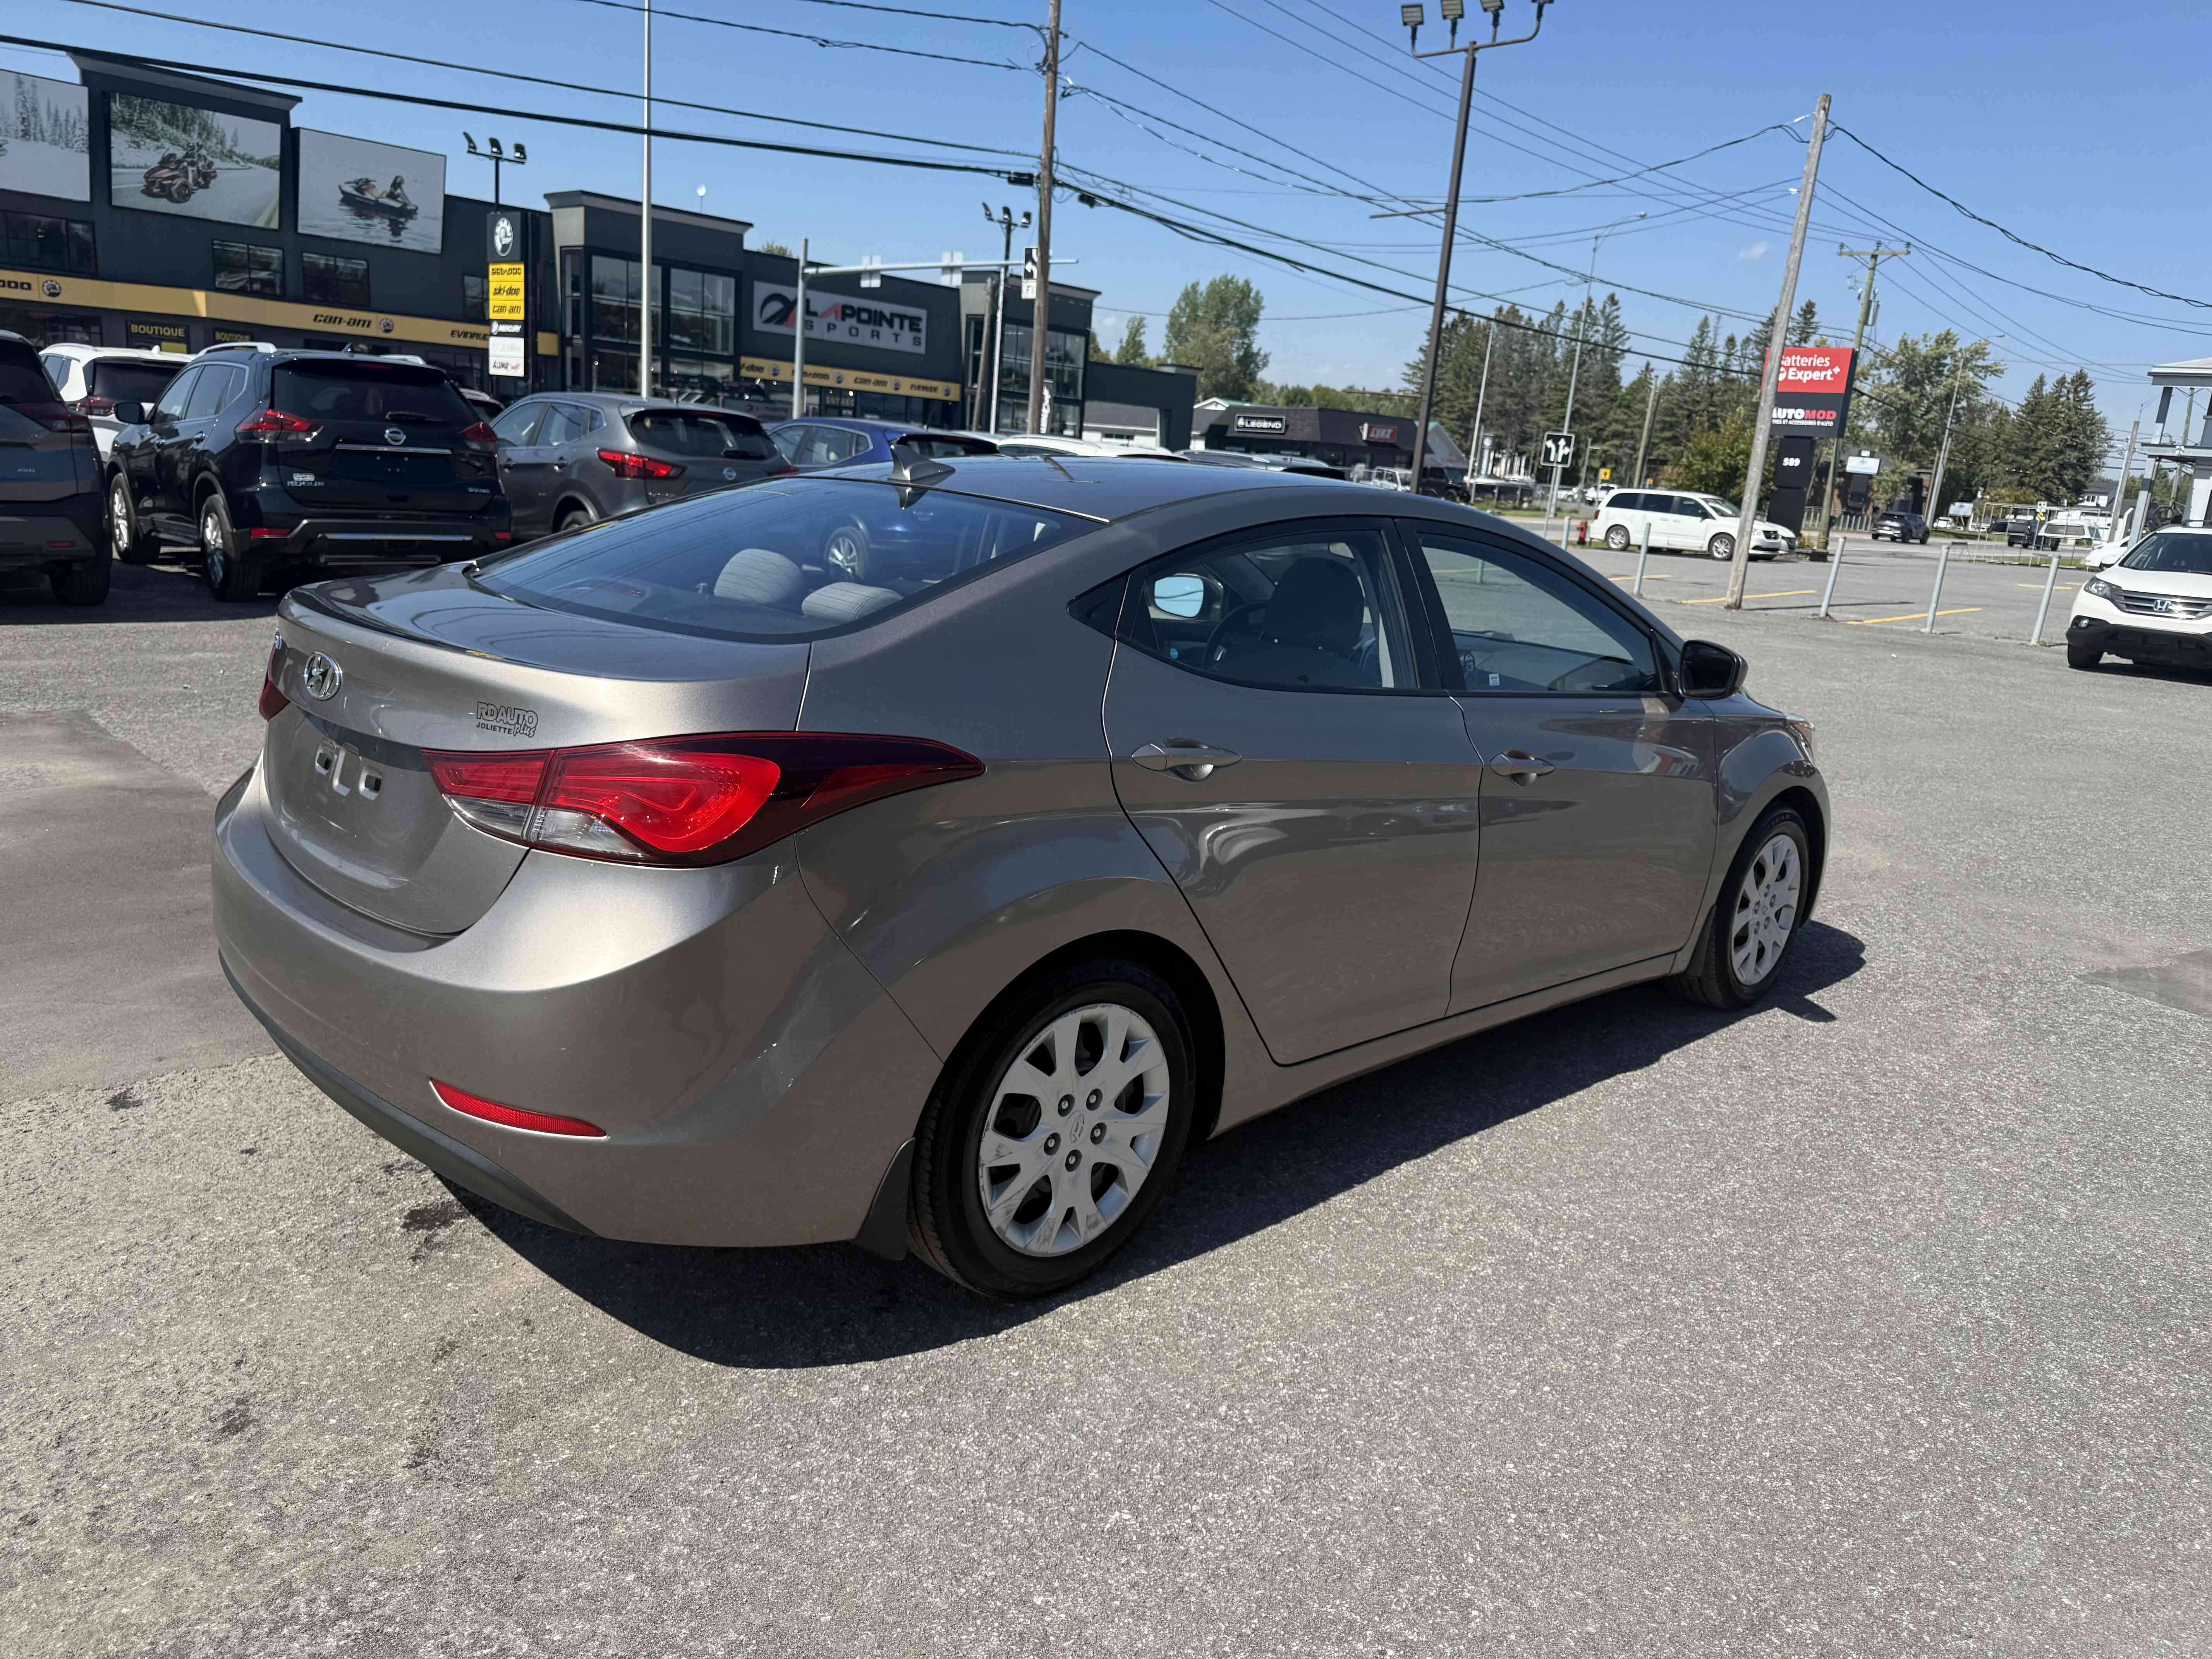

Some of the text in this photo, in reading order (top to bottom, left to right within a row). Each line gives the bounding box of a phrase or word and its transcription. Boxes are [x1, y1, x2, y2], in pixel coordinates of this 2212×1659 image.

[492, 305, 521, 314] can-am
[806, 298, 922, 333] LAPOINTE
[313, 313, 372, 329] can-am
[131, 324, 185, 337] BOUTIQUE
[215, 331, 251, 342] BOUTIQUE
[804, 319, 921, 347] SPORTS
[854, 377, 888, 388] can-am
[1245, 419, 1282, 429] LEGEND
[1783, 457, 1800, 467] 589
[476, 720, 536, 738] JOLIETTE plus
